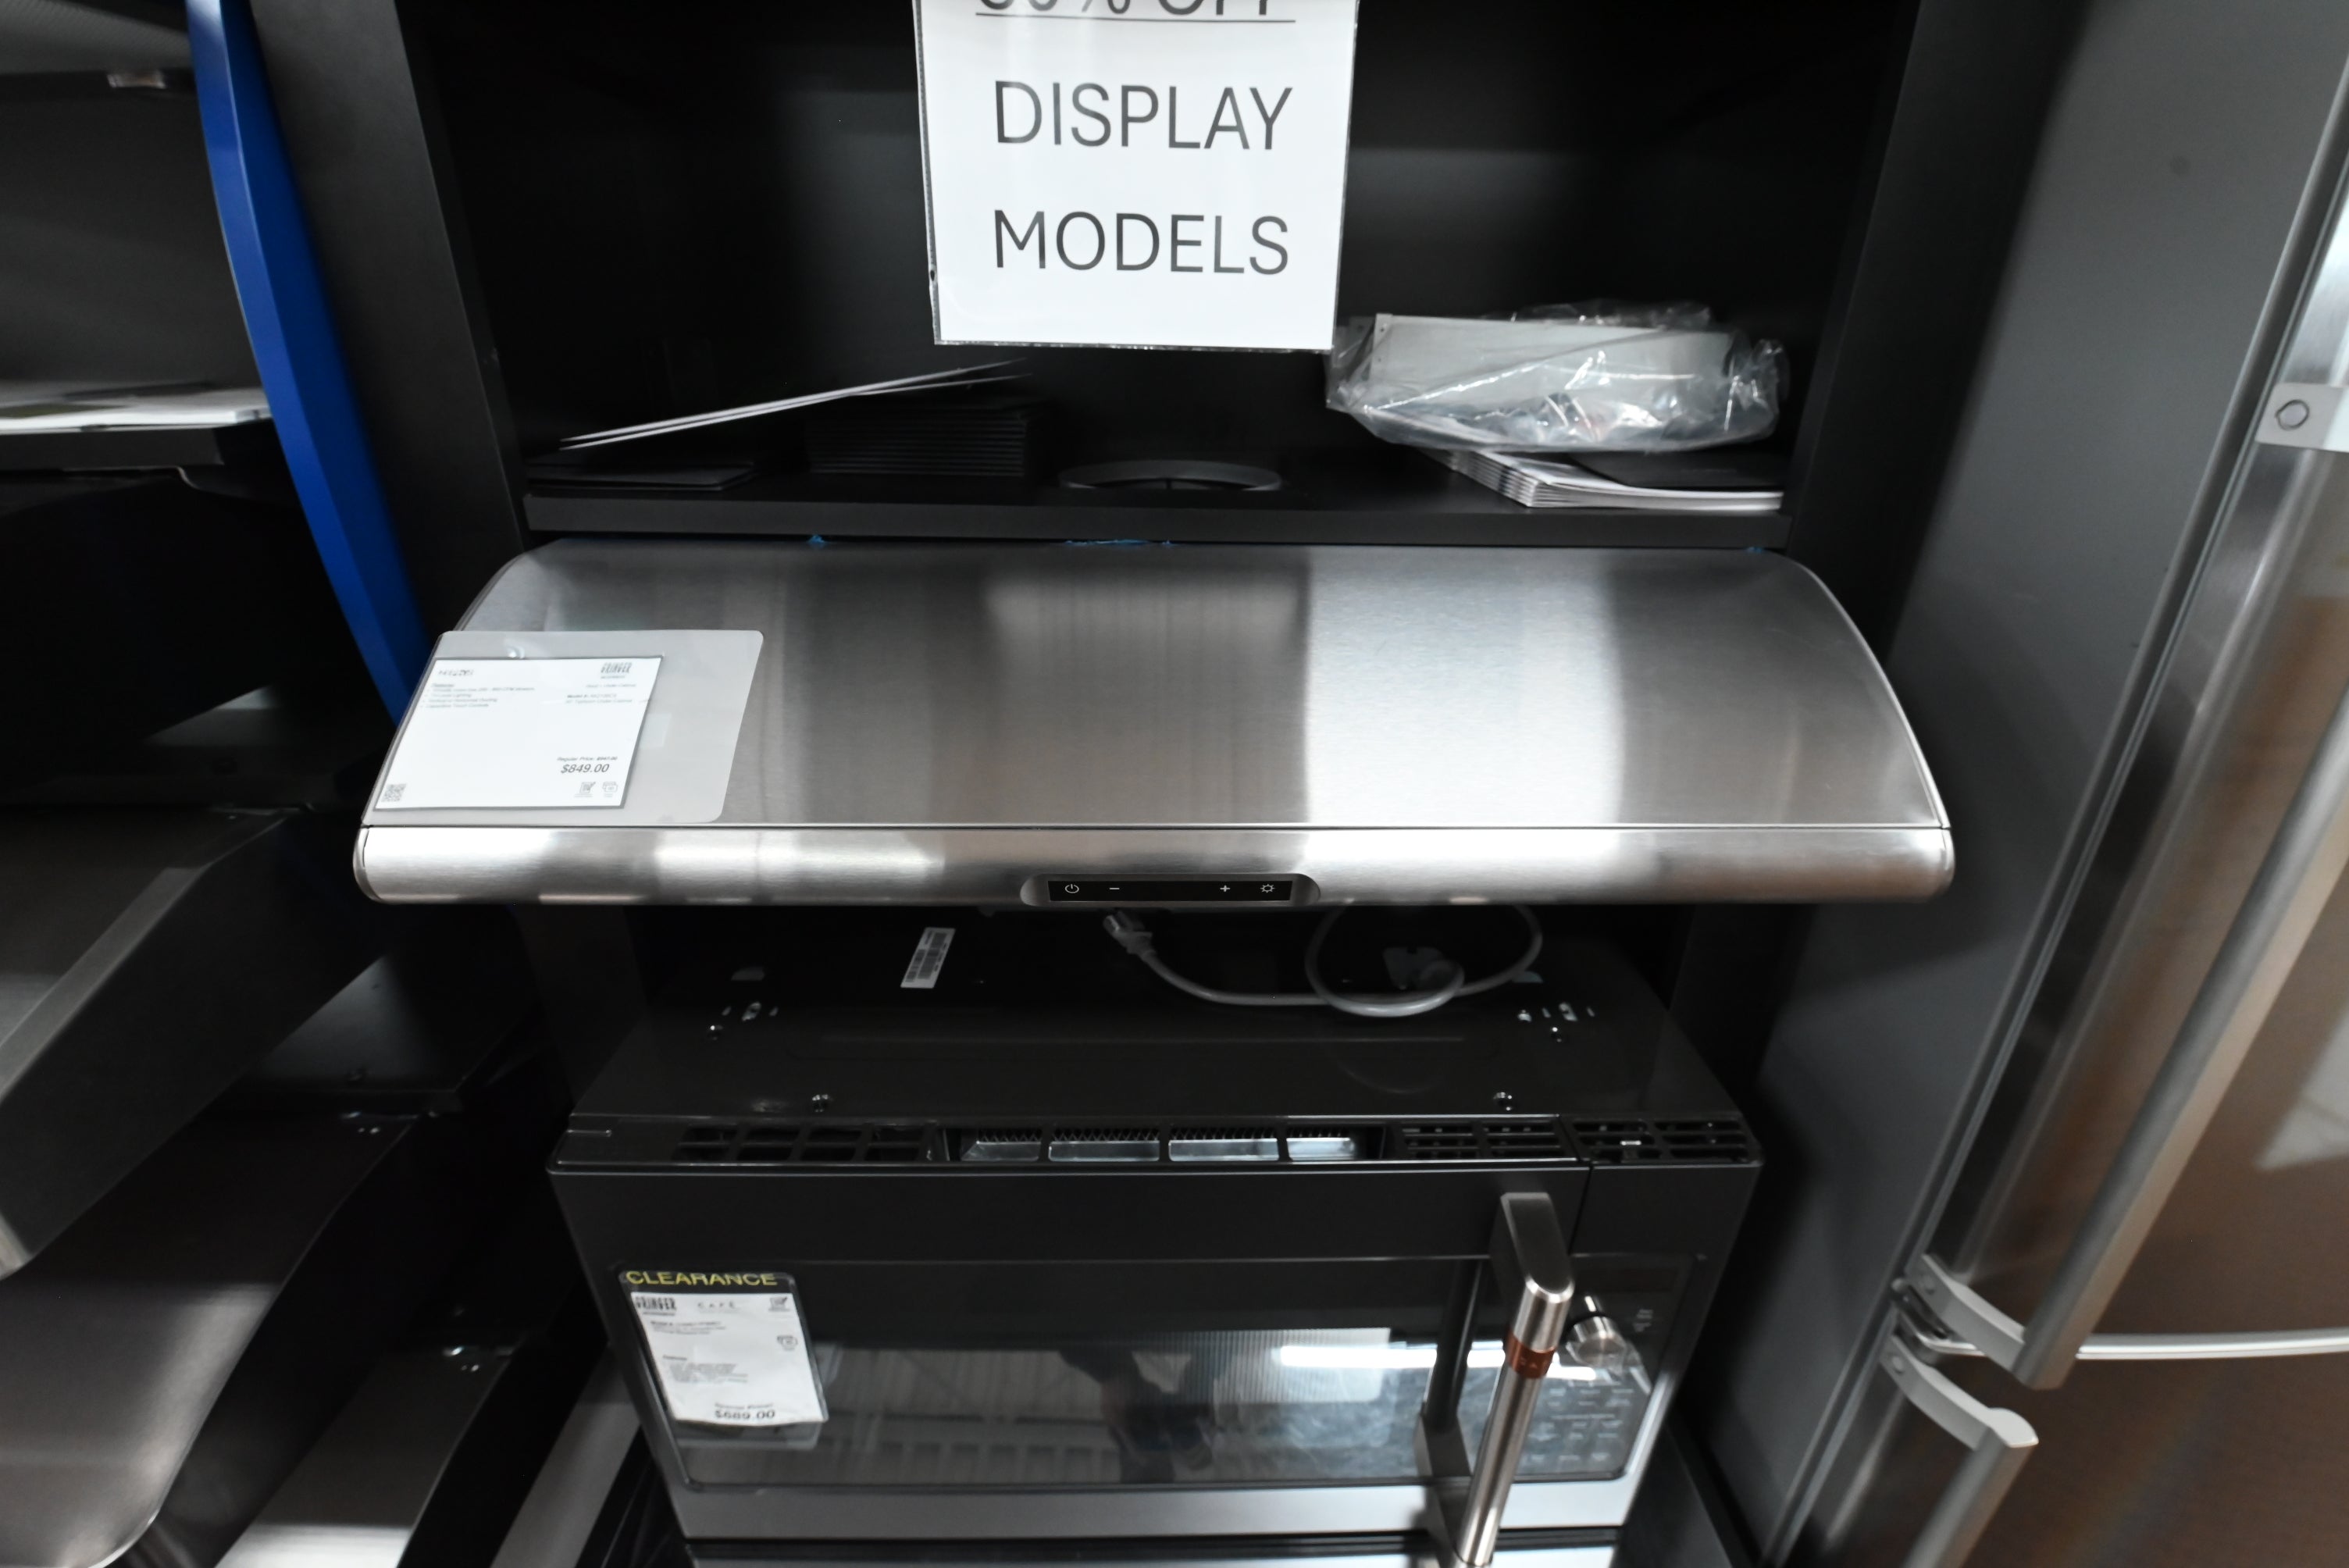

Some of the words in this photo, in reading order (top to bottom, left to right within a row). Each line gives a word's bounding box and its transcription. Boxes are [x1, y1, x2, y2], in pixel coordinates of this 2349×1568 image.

[994, 80, 1293, 150] DISPLAY
[993, 208, 1289, 275] MODELS
[560, 763, 610, 774] $849.00
[626, 1271, 777, 1285] CLEARANCE
